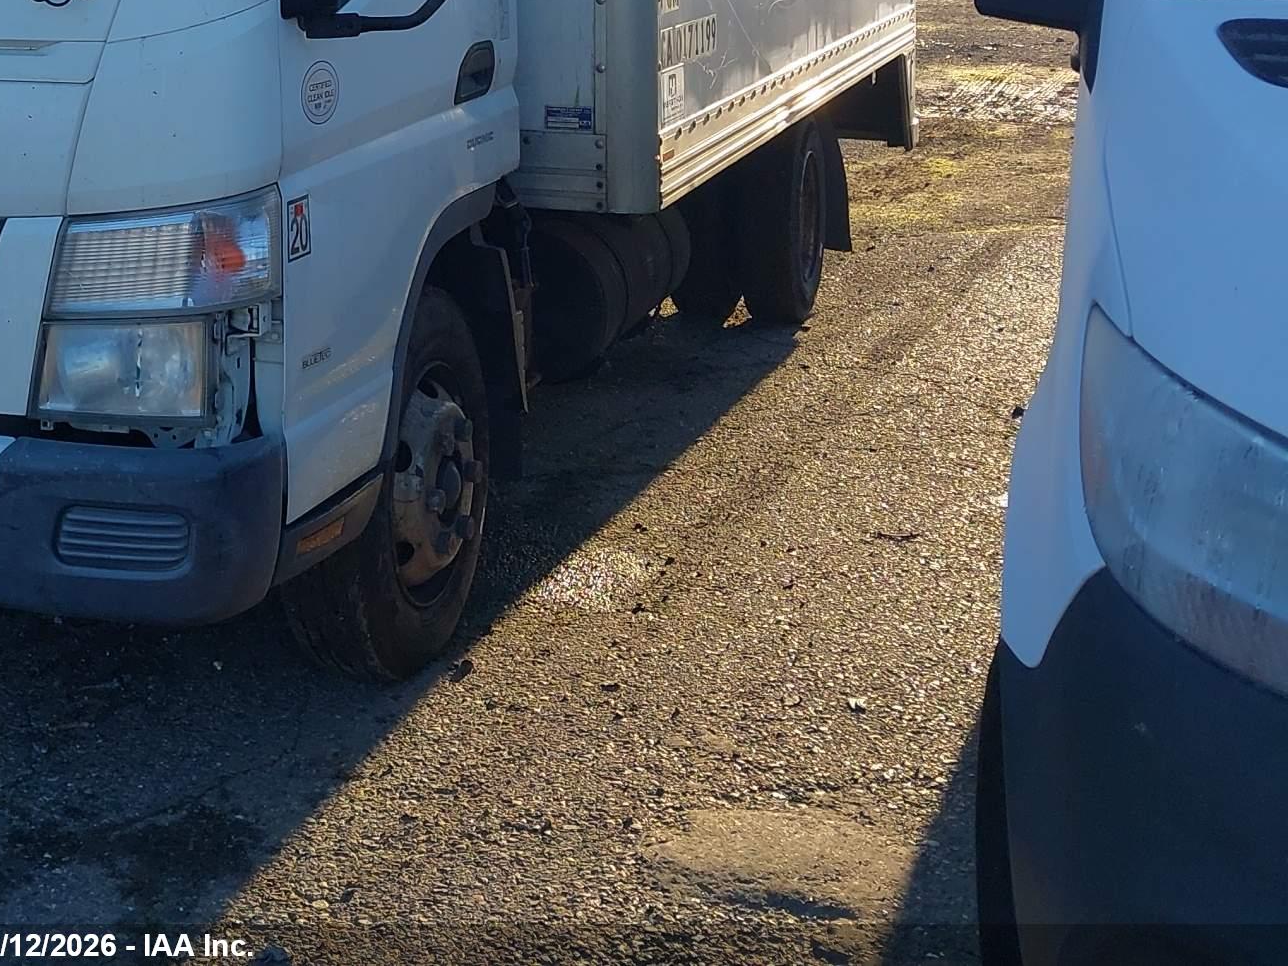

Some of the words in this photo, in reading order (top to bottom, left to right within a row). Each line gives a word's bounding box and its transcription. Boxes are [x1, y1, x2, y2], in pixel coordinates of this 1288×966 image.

[676, 17, 717, 61] 0171199
[307, 92, 324, 103] CLEAN
[324, 89, 335, 98] IDLE
[290, 215, 309, 256] 20
